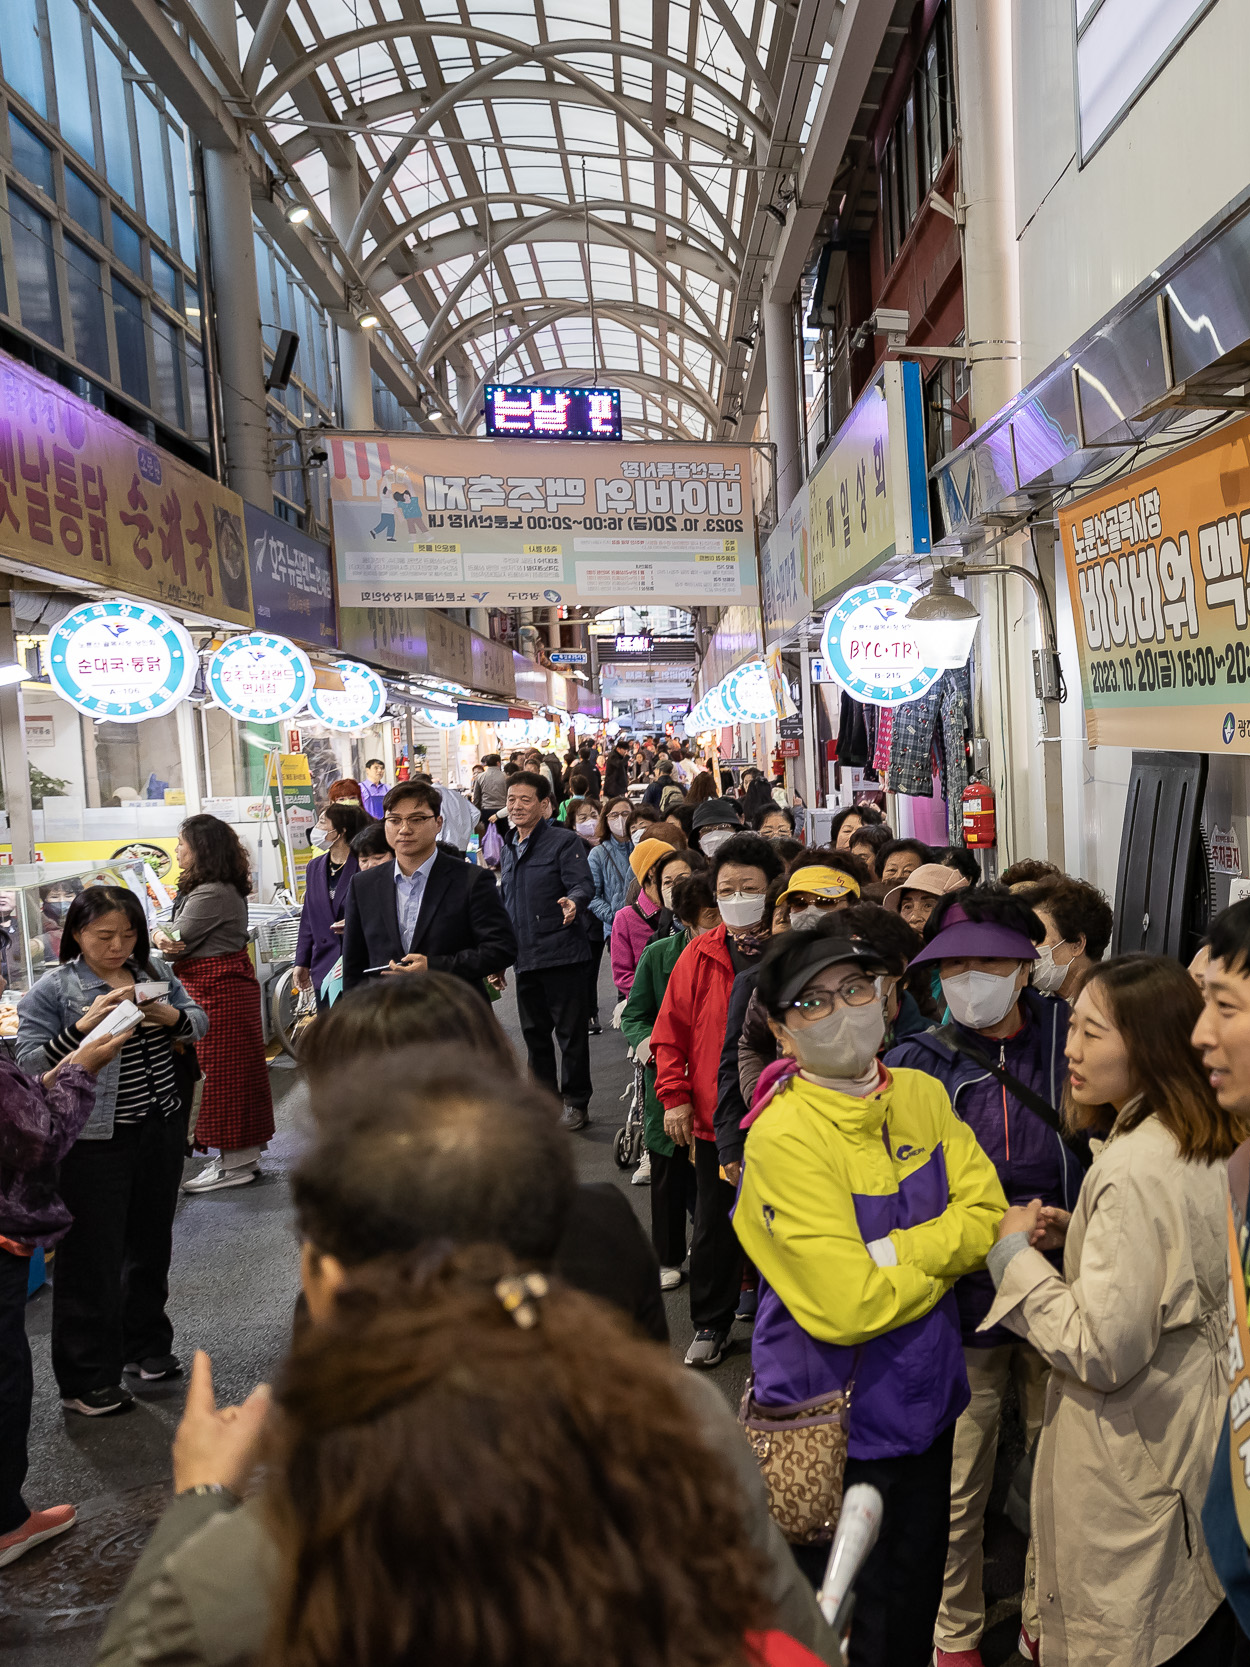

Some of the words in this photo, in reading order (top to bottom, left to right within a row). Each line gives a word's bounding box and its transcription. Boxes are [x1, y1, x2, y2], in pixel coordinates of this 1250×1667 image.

[826, 434, 887, 549] 제일상회
[1072, 487, 1162, 565] 노룬산골목시장
[1078, 530, 1199, 651] 비어비워
[222, 670, 246, 682] 호주
[249, 669, 294, 681] 뉴질랜드
[242, 683, 277, 695] 면세점
[1091, 659, 1118, 693] 2023.
[1120, 657, 1137, 691] 10.
[1136, 648, 1177, 690] 20(금)
[1211, 845, 1240, 869] 주차금지
